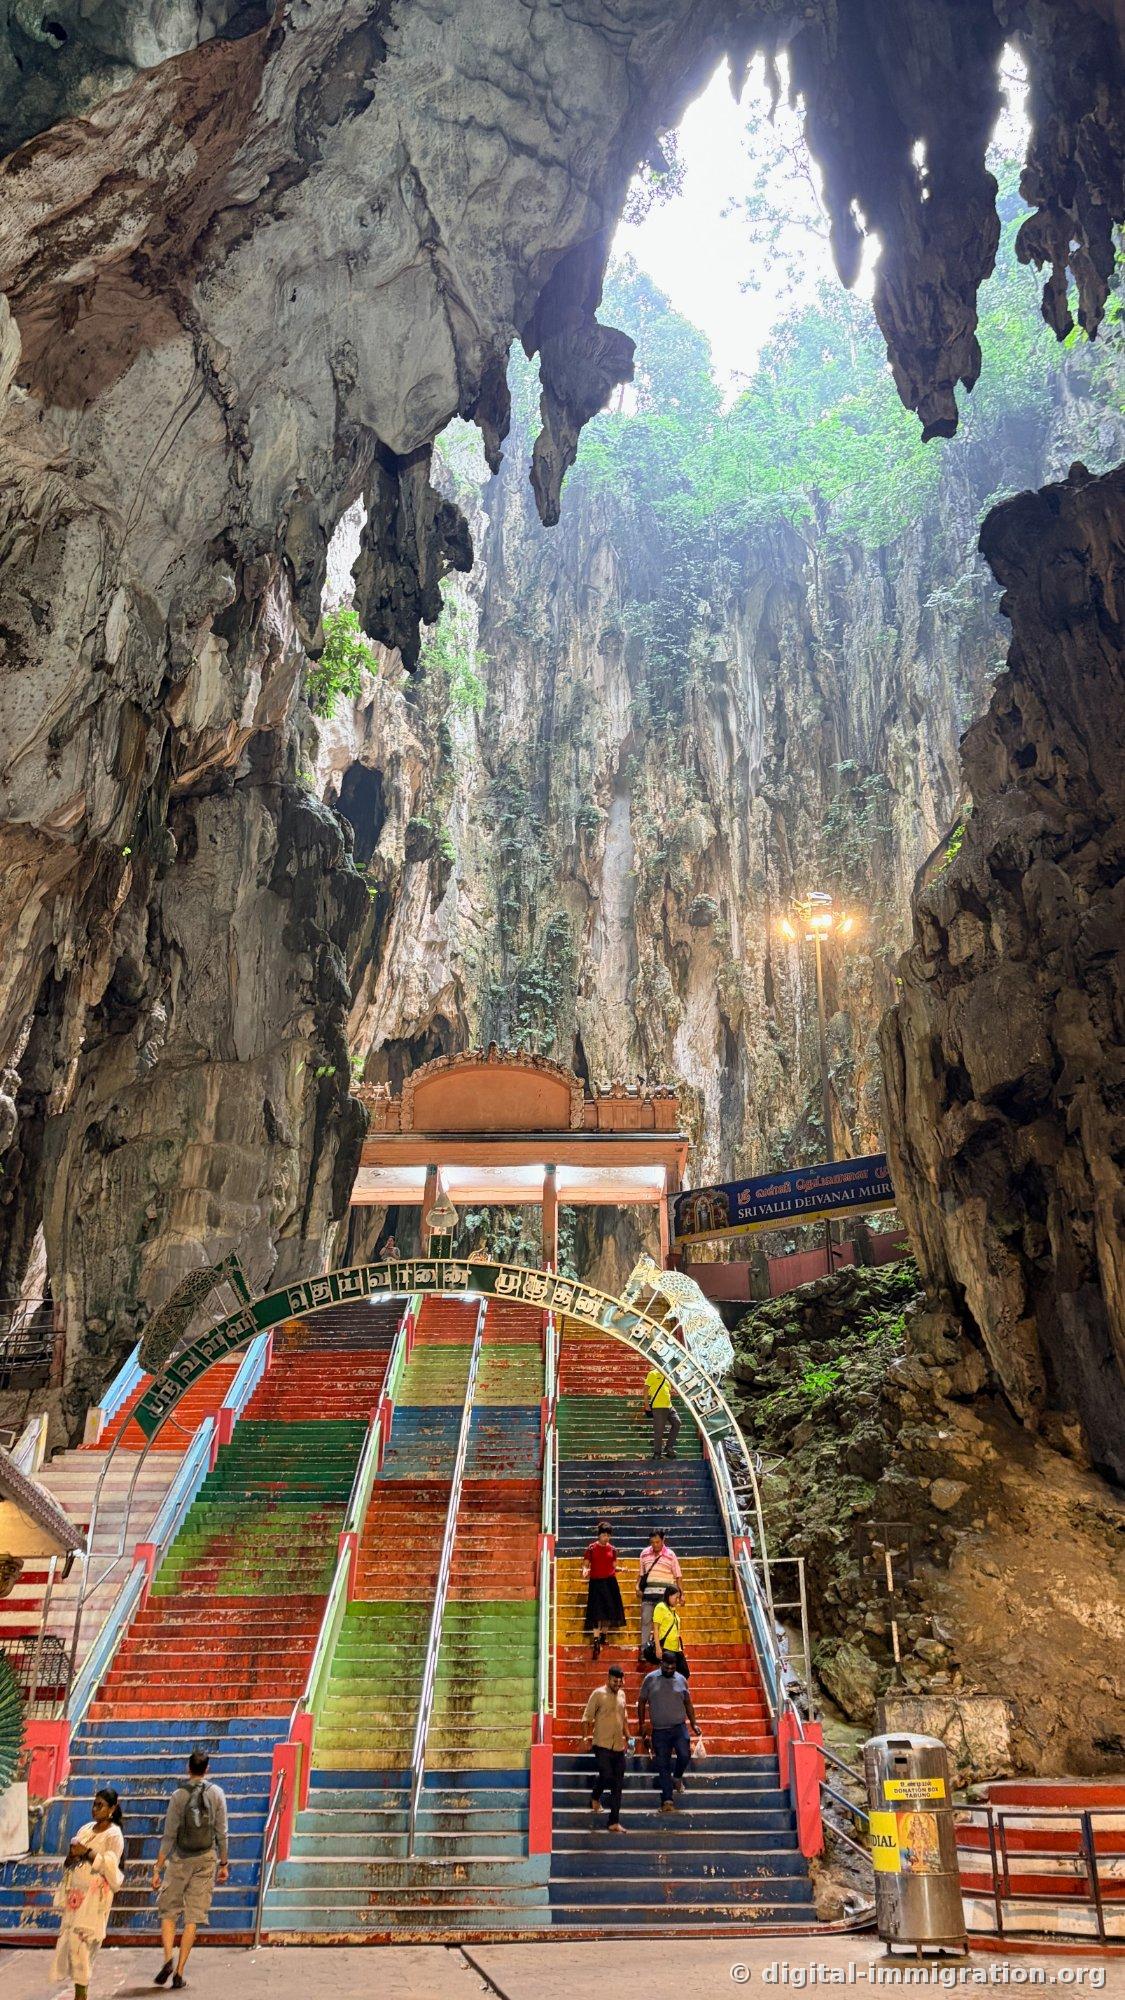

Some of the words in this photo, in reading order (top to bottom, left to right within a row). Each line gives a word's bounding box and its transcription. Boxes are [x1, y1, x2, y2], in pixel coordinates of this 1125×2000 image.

[738, 1205, 757, 1219] SRI
[758, 1200, 792, 1216] VALLI
[795, 1188, 855, 1209] DEIVANAI
[495, 1273, 604, 1321] முருகன்
